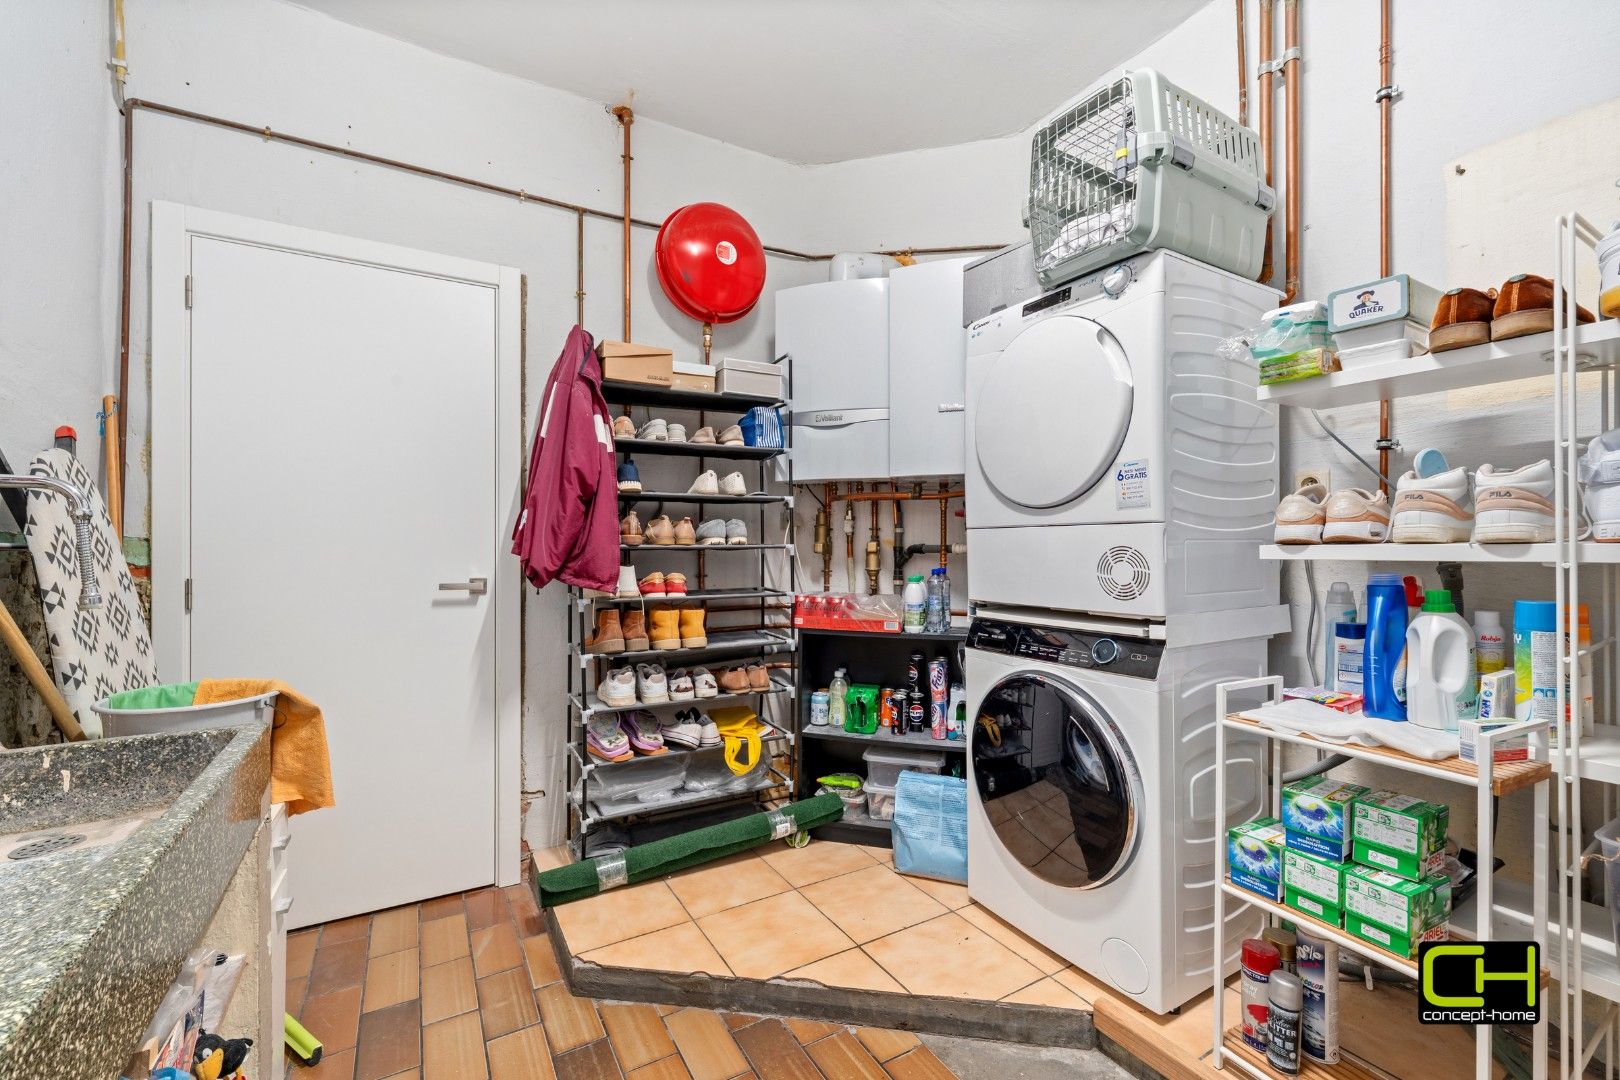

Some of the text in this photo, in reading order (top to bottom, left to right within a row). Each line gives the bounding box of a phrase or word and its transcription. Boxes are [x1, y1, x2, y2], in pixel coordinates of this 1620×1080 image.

[1349, 305, 1384, 319] QUAKER
[1117, 470, 1148, 481] 6 GRATIS
[1427, 852, 1442, 868] ARIEL
[1424, 925, 1444, 941] ARIEL
